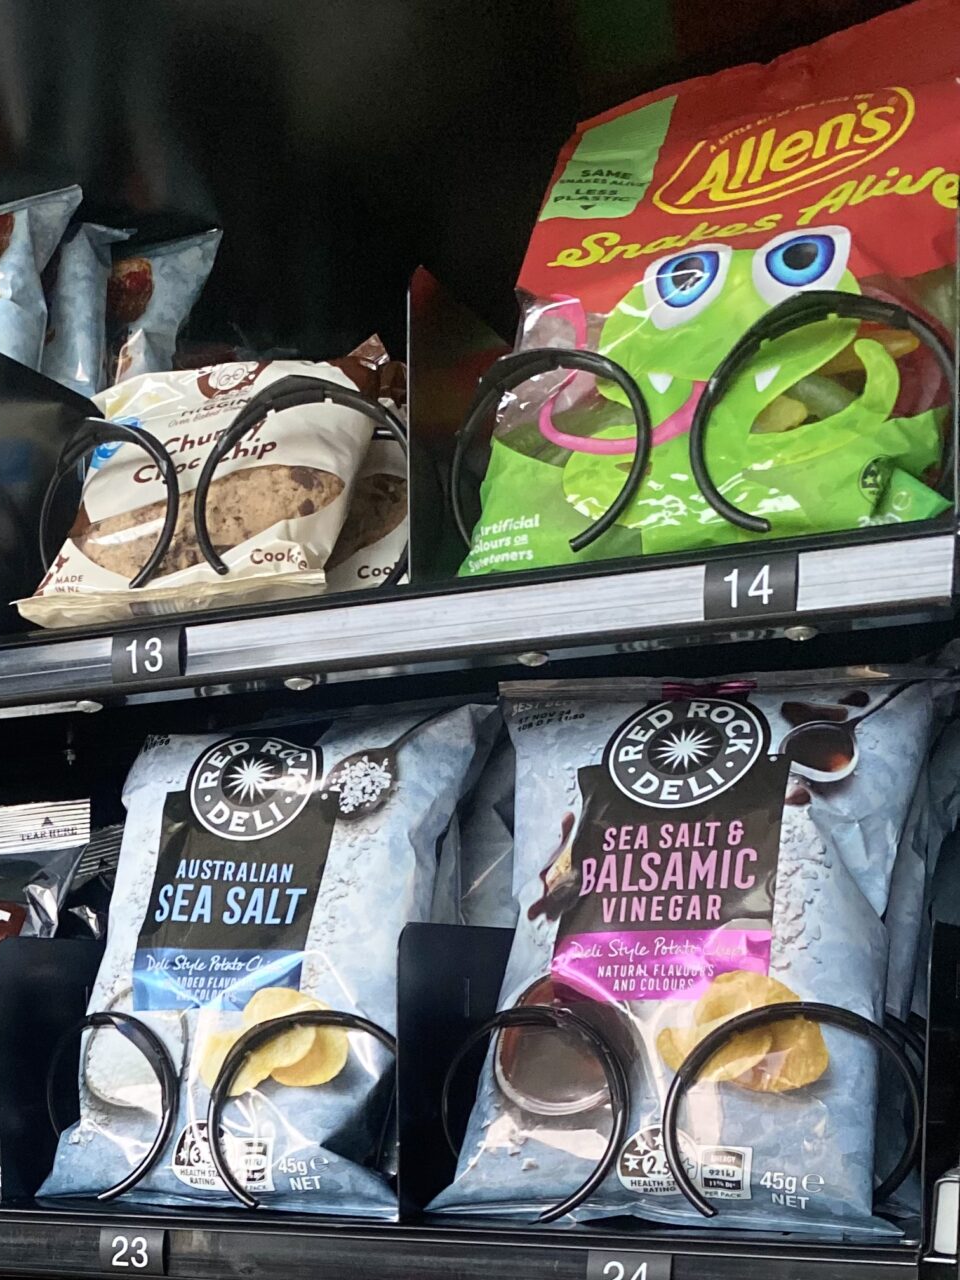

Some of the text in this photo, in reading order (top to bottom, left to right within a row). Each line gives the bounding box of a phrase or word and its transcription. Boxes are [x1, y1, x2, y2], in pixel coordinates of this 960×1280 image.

[674, 102, 895, 205] Allen's
[581, 169, 633, 180] SAME
[575, 188, 618, 196] LESS
[546, 167, 959, 267] Snakes Alive
[250, 547, 310, 572] Cookie
[55, 573, 84, 585] MADE
[723, 564, 773, 608] 14
[125, 636, 164, 675] 13
[619, 701, 755, 763] RED ROCK
[198, 741, 251, 791] RED
[631, 767, 726, 801] DELI
[206, 801, 283, 833] DELI
[19, 827, 79, 843] TEAR HERE
[602, 820, 745, 852] SEA SALT &
[175, 859, 294, 884] AUSTRALIAN
[580, 847, 757, 897] BALSAMIC
[154, 884, 308, 925] SEA SALT
[602, 894, 722, 923] VINEGAR
[146, 953, 170, 971] Deli
[172, 954, 207, 972] Style
[208, 956, 246, 971] Potato
[570, 938, 649, 963] Deli Style
[597, 963, 715, 978] NATURAL FLAVOURS
[613, 977, 694, 992] AND COLOURS
[180, 1168, 207, 1177] HEALTH
[278, 1157, 308, 1176] 45g
[189, 1177, 216, 1187] RATING
[289, 1176, 321, 1191] NET
[629, 1179, 659, 1189] HEALTH
[643, 1185, 677, 1194] RATING
[759, 1171, 798, 1194] 45g
[771, 1194, 810, 1211] NET
[111, 1235, 149, 1268] 23
